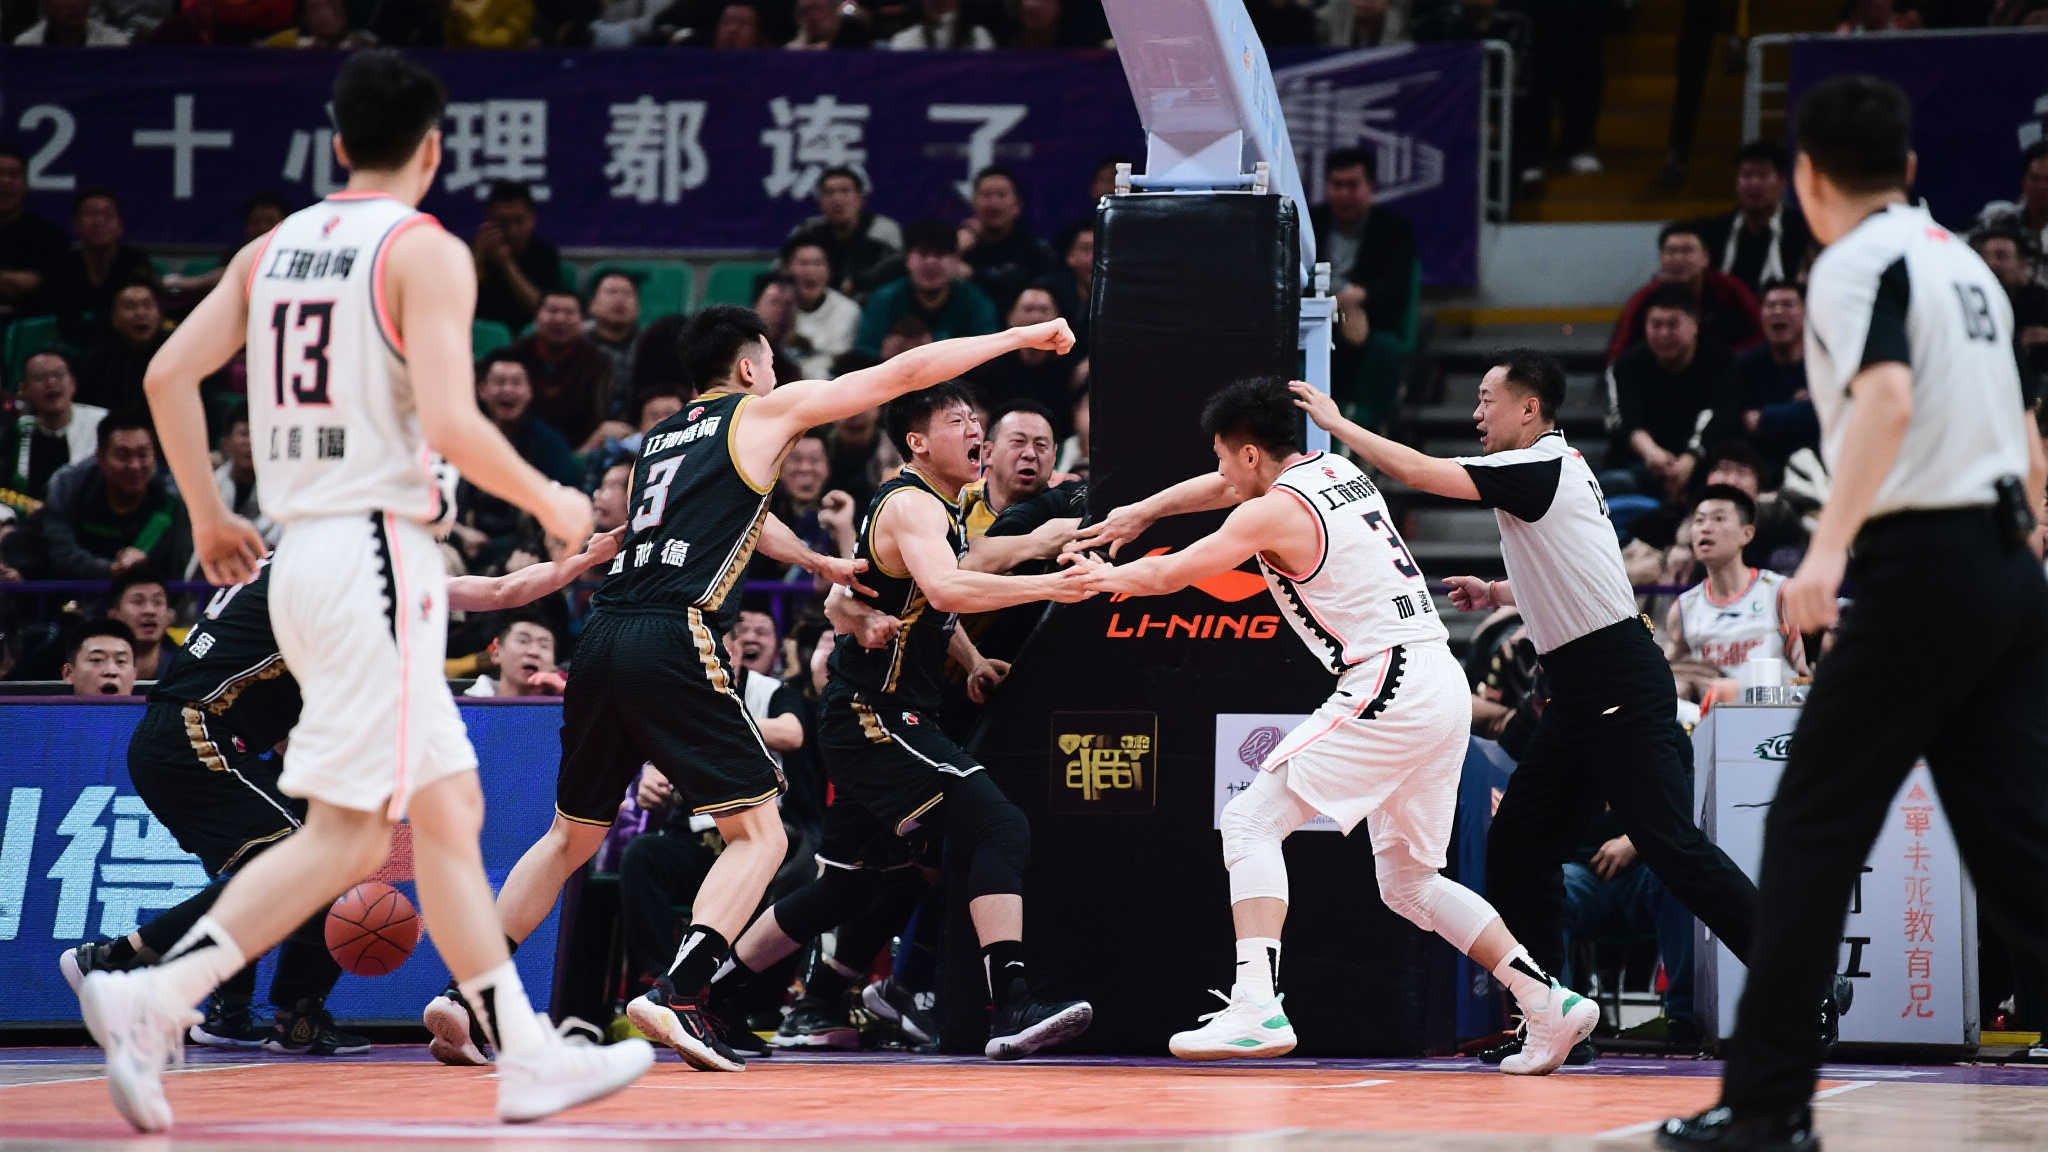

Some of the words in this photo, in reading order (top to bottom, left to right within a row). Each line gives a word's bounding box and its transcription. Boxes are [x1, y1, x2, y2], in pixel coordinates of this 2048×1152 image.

[271, 300, 337, 408] 13
[632, 454, 686, 534] 3
[1360, 509, 1420, 579] 3
[1106, 613, 1280, 639] LI-NING
